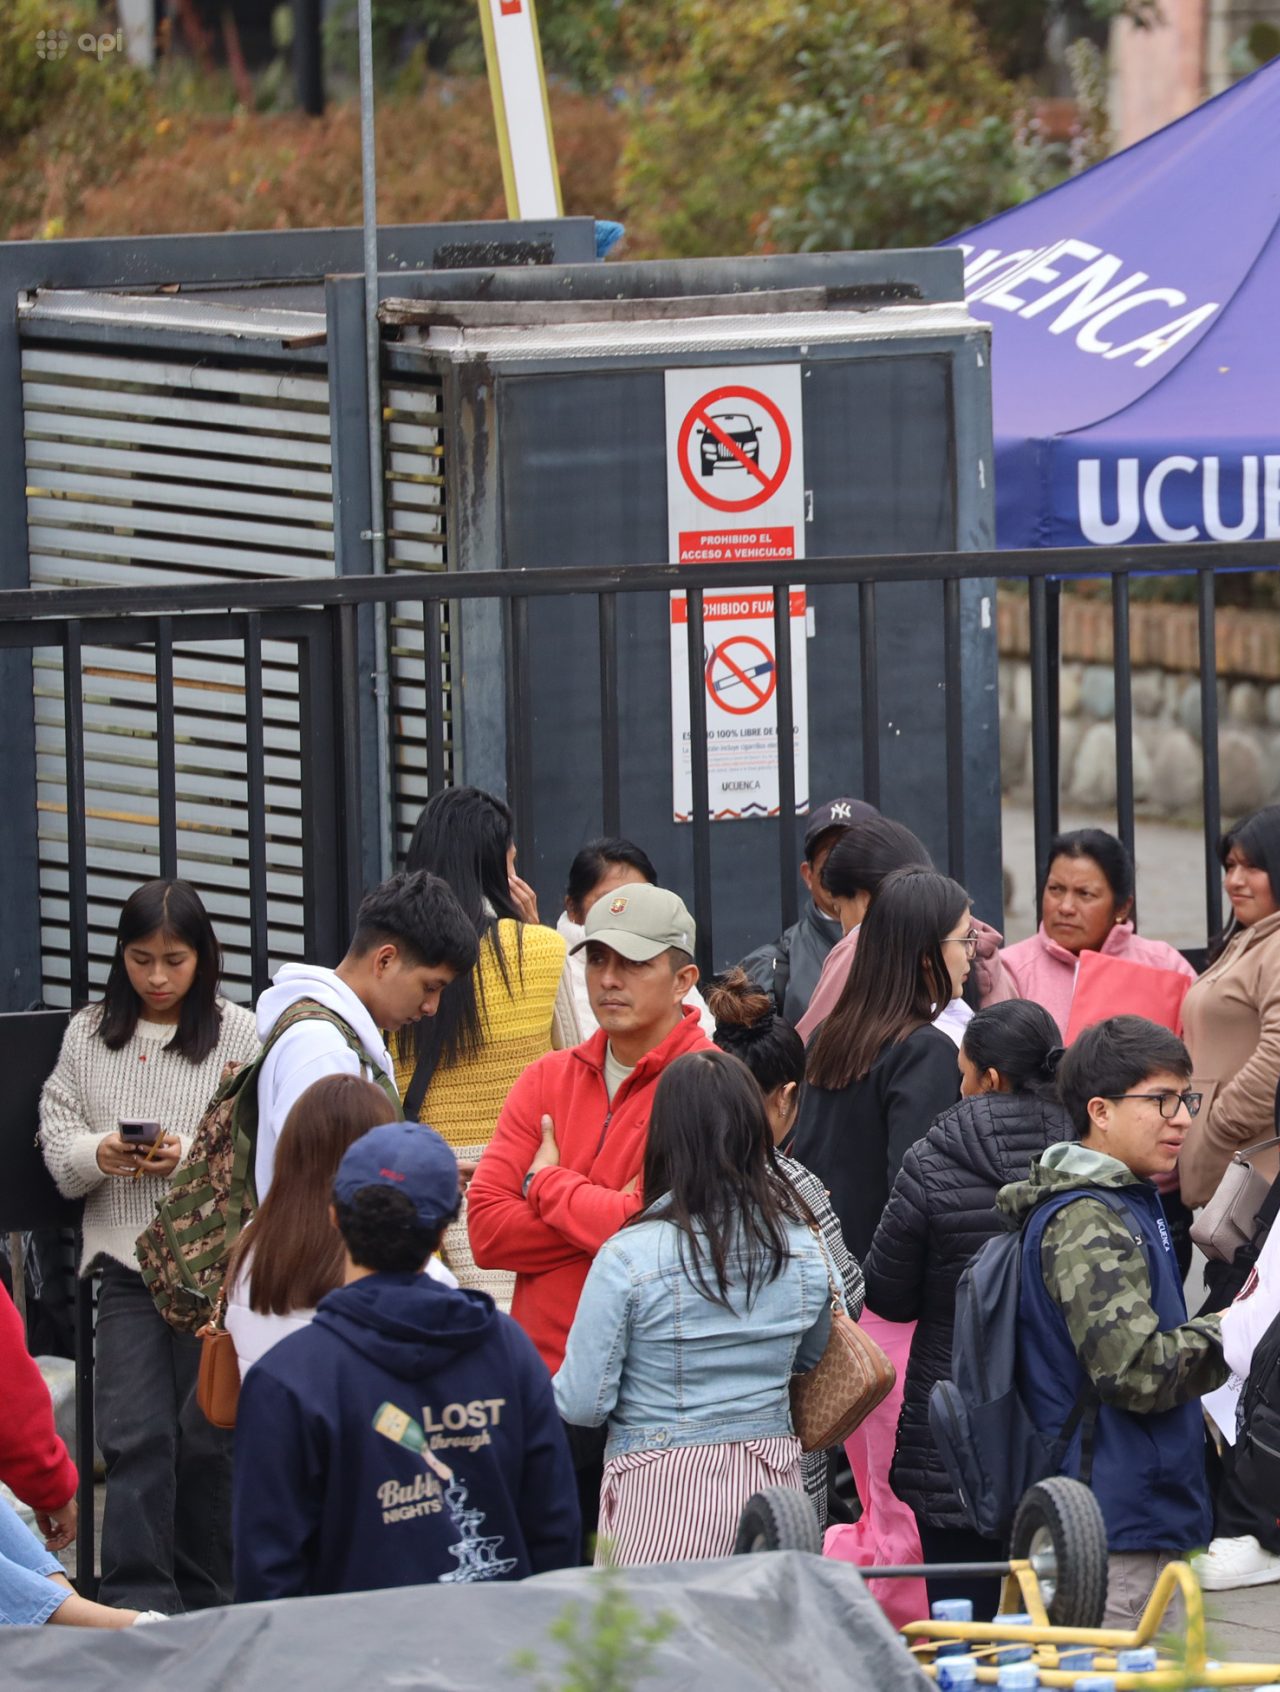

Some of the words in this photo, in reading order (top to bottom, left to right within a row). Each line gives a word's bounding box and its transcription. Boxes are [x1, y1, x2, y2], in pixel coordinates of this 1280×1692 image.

[701, 534, 757, 545] PROHIBIDO
[759, 533, 772, 543] EL
[681, 549, 722, 560] ACCESO
[724, 548, 732, 558] A
[734, 546, 793, 558] VEHICULOS
[716, 729, 738, 738] 100%
[740, 727, 761, 737] LIBRE
[763, 726, 774, 736] DE
[721, 780, 761, 792] UCUENCA
[831, 802, 851, 821] NY
[1156, 1218, 1170, 1252] UCUENCA
[421, 1398, 506, 1433] LOST
[429, 1429, 492, 1453] through
[382, 1498, 443, 1525] NIGHTS
